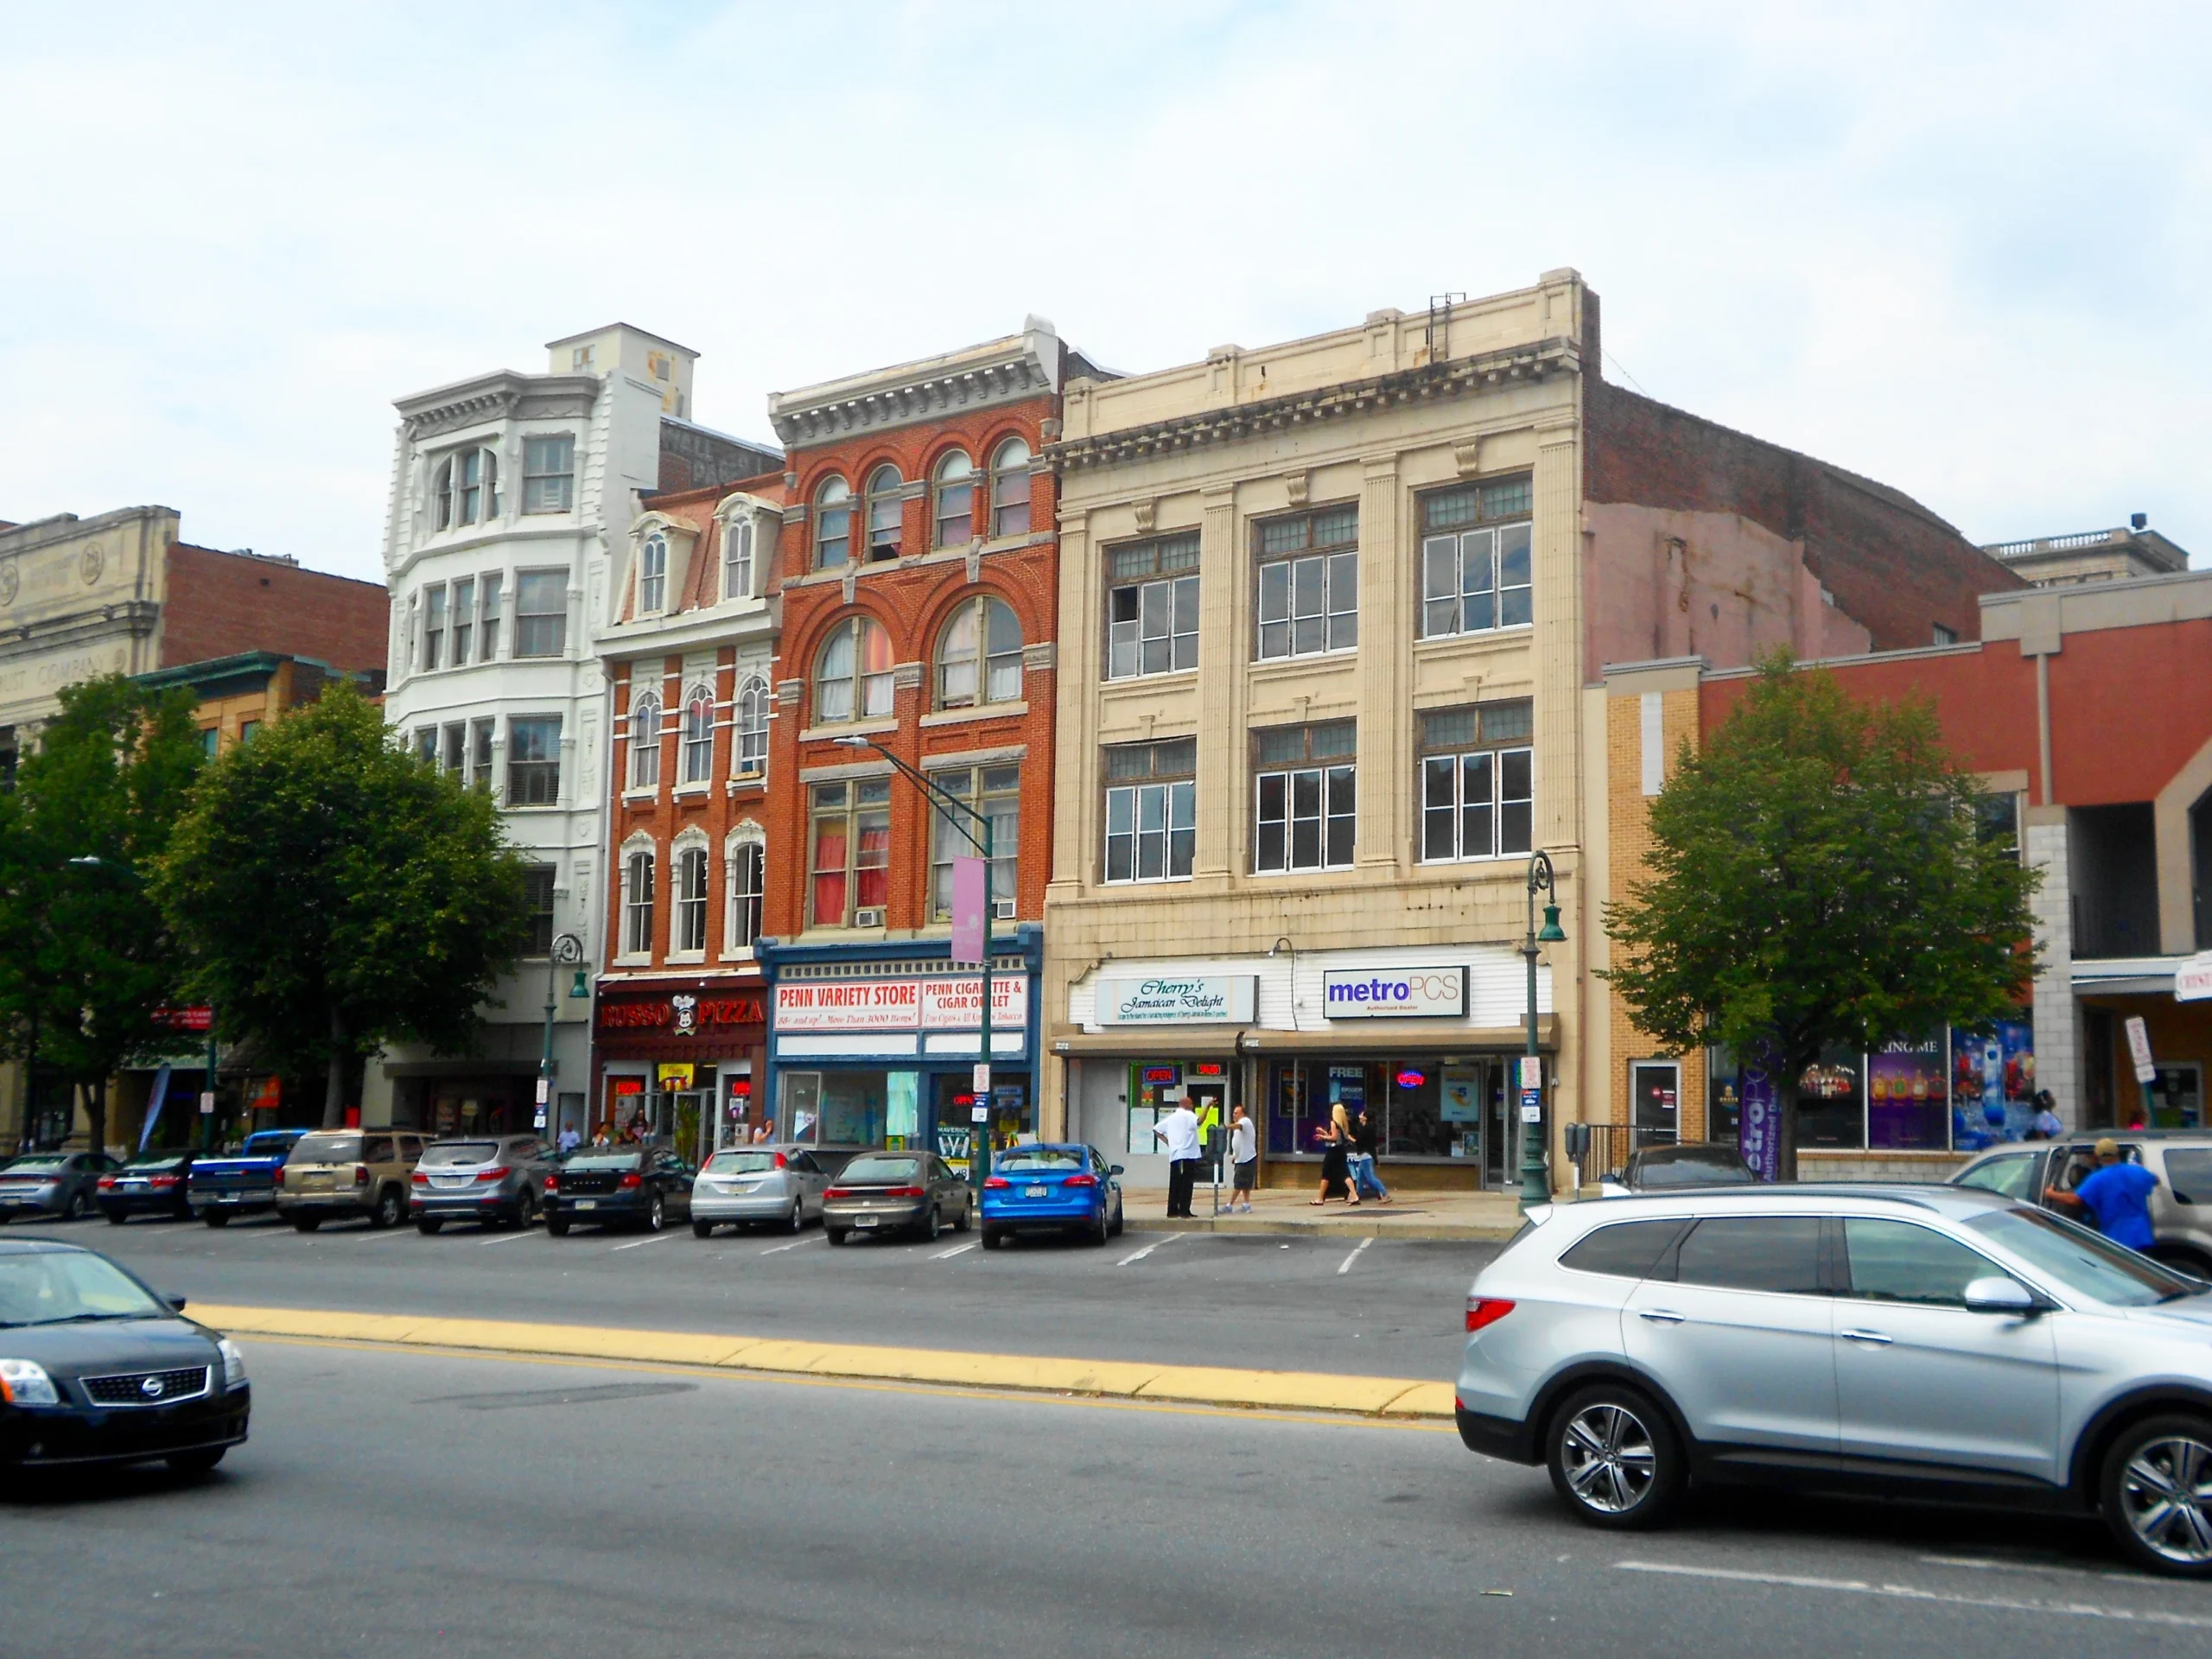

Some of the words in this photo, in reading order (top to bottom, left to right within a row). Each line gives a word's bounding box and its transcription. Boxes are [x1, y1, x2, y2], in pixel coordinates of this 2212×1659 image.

[925, 984, 952, 995] PENN
[956, 981, 1010, 995] CIGATTE
[1014, 981, 1021, 994] &
[1141, 979, 1205, 996] Cherry's
[1329, 976, 1459, 1001] metroPCS
[779, 988, 813, 1008] PENN
[817, 987, 871, 1007] VARIETY
[874, 985, 916, 1005] STORE
[938, 996, 968, 1008] CIGAR
[971, 995, 1009, 1007] OULET
[1121, 996, 1176, 1013] Jamaican
[1180, 994, 1224, 1013] Delight
[601, 1002, 670, 1027] RUSSO
[698, 999, 764, 1025] PIZZA
[847, 1014, 864, 1024] Than
[1147, 1071, 1173, 1082] OPEN
[1329, 1066, 1363, 1078] FREE
[1397, 1073, 1424, 1085] OPEN
